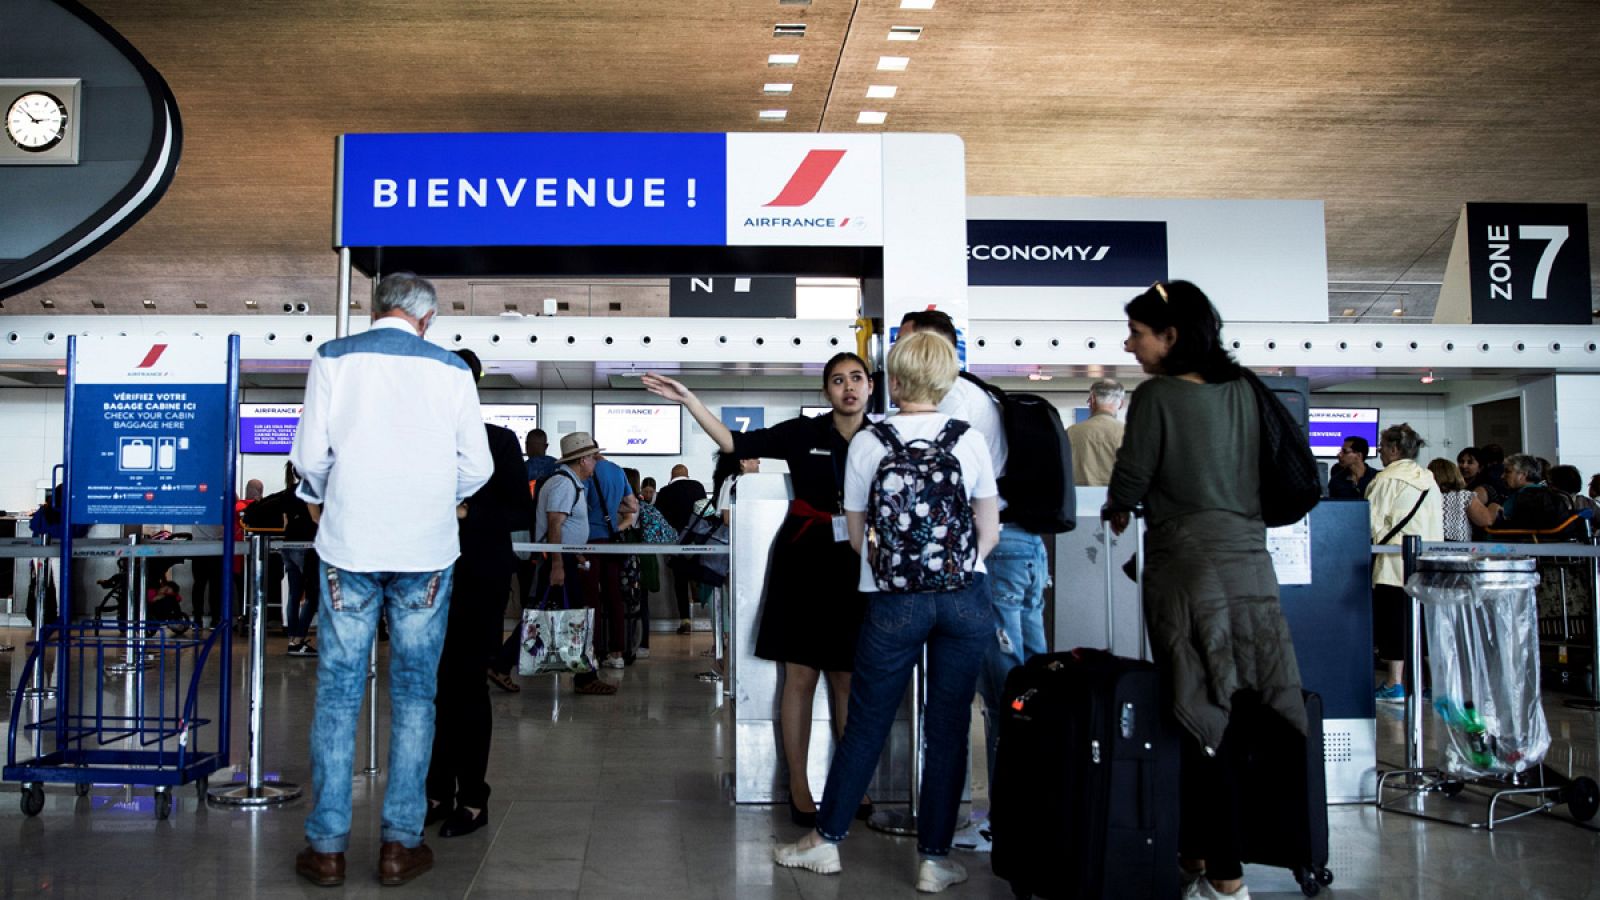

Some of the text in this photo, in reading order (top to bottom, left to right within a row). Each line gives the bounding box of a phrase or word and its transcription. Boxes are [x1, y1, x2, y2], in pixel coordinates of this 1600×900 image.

[373, 178, 697, 207] BIENVENUE !
[744, 217, 835, 227] AIRFRANCE
[1488, 225, 1513, 300] ZONE
[1519, 225, 1569, 299] 7
[113, 392, 187, 401] VÉRIFIEZ VOTRE
[103, 402, 196, 410] BAGAGE CABINE ICI
[104, 412, 195, 420] CHECK YOUR CABIN
[113, 421, 185, 429] BAGGAGE HERE
[735, 417, 750, 434] 7
